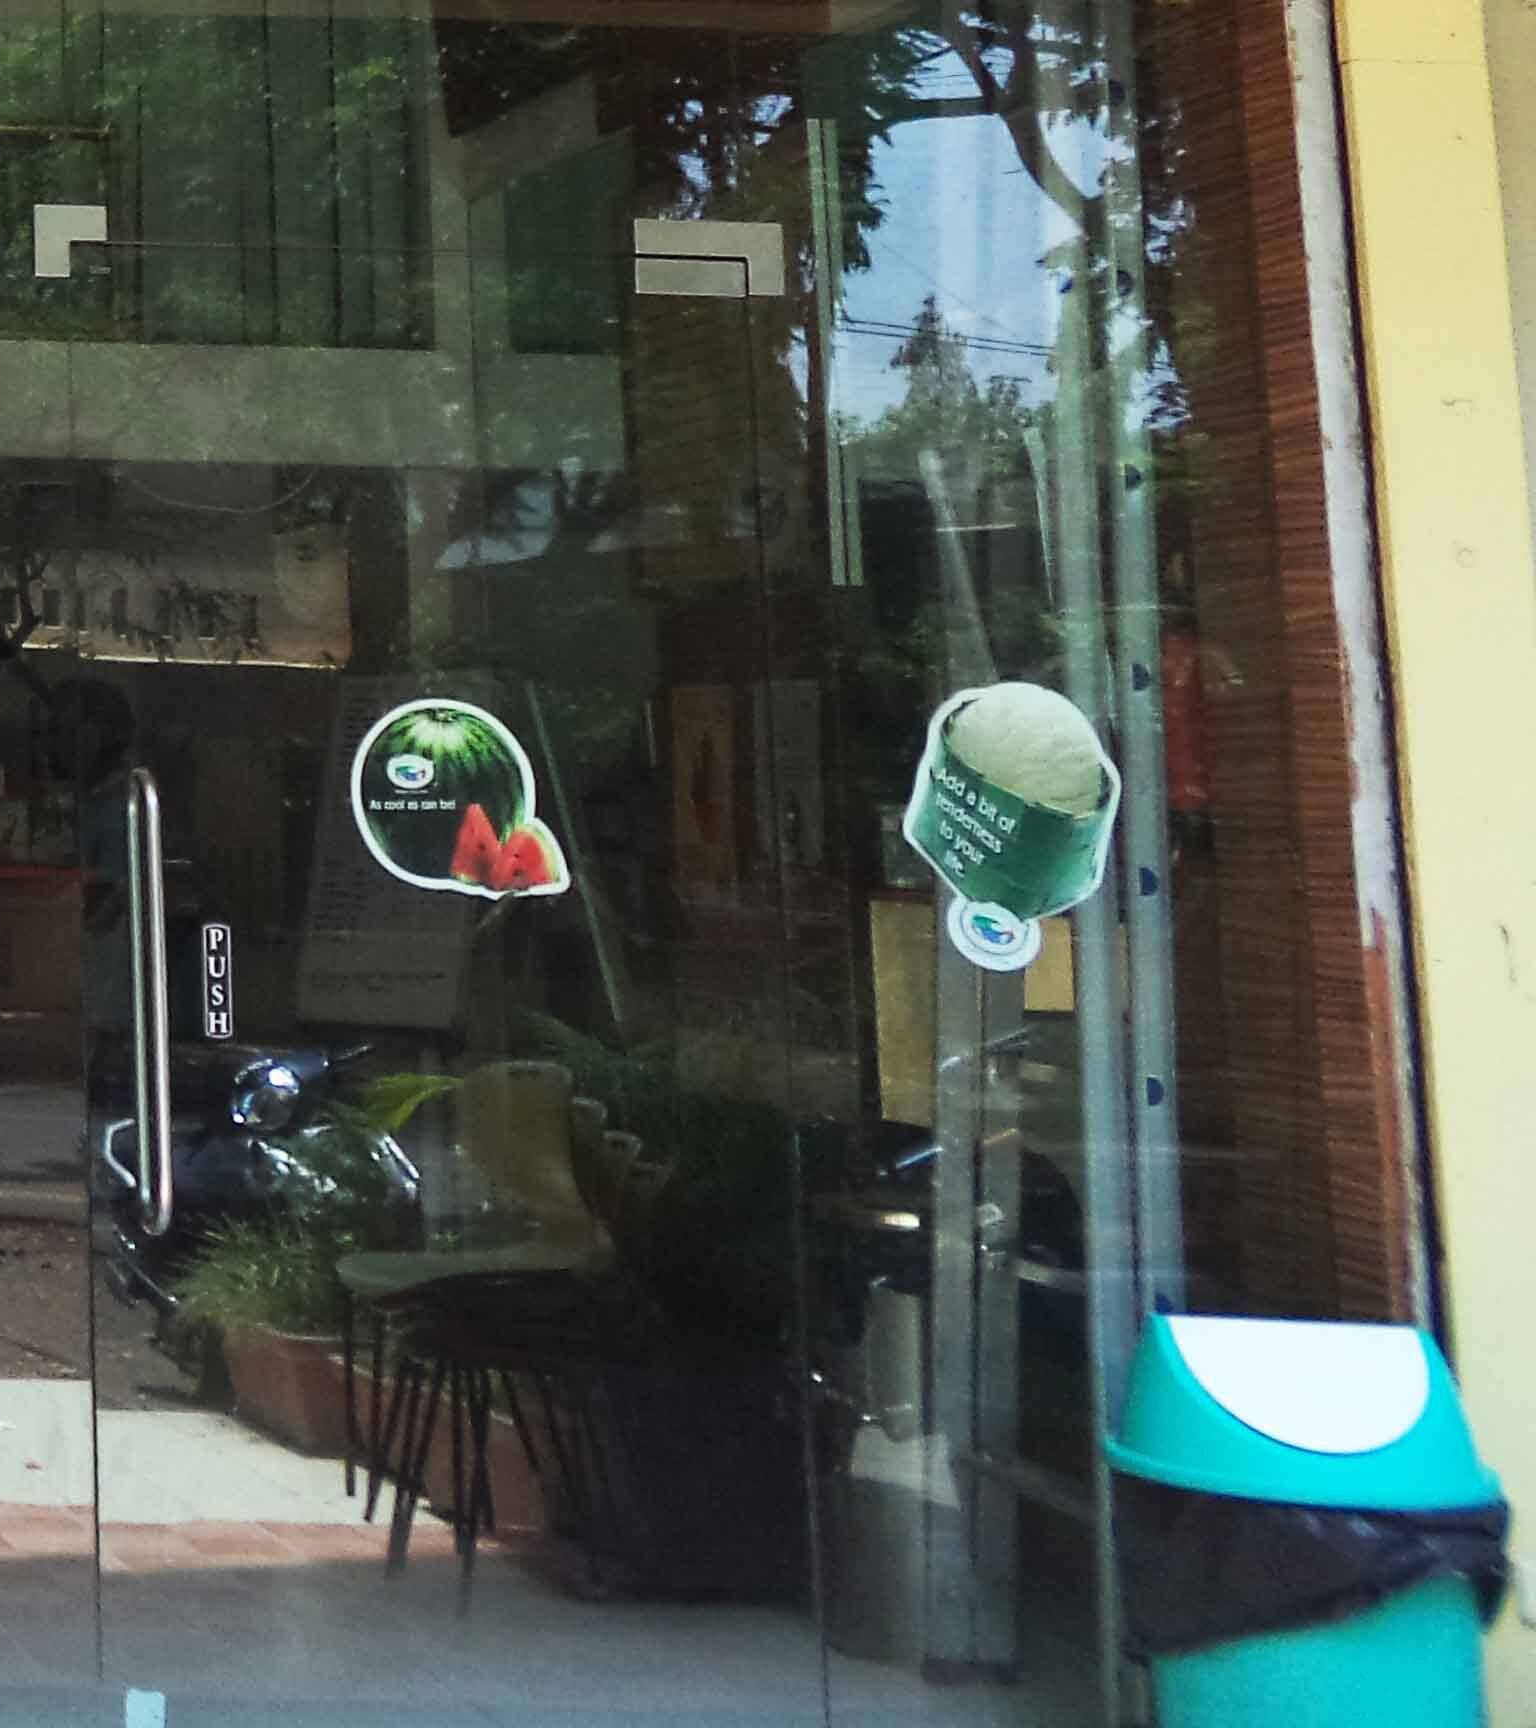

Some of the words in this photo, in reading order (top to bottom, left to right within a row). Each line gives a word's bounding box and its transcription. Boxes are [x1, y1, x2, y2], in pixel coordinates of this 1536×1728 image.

[933, 768, 965, 798] Add
[966, 789, 976, 805] a
[977, 798, 997, 822] bit
[998, 816, 1016, 835] of
[936, 792, 1002, 854] tenderness
[940, 821, 953, 840] to
[954, 834, 985, 866] your
[207, 928, 229, 1033] PUSH
